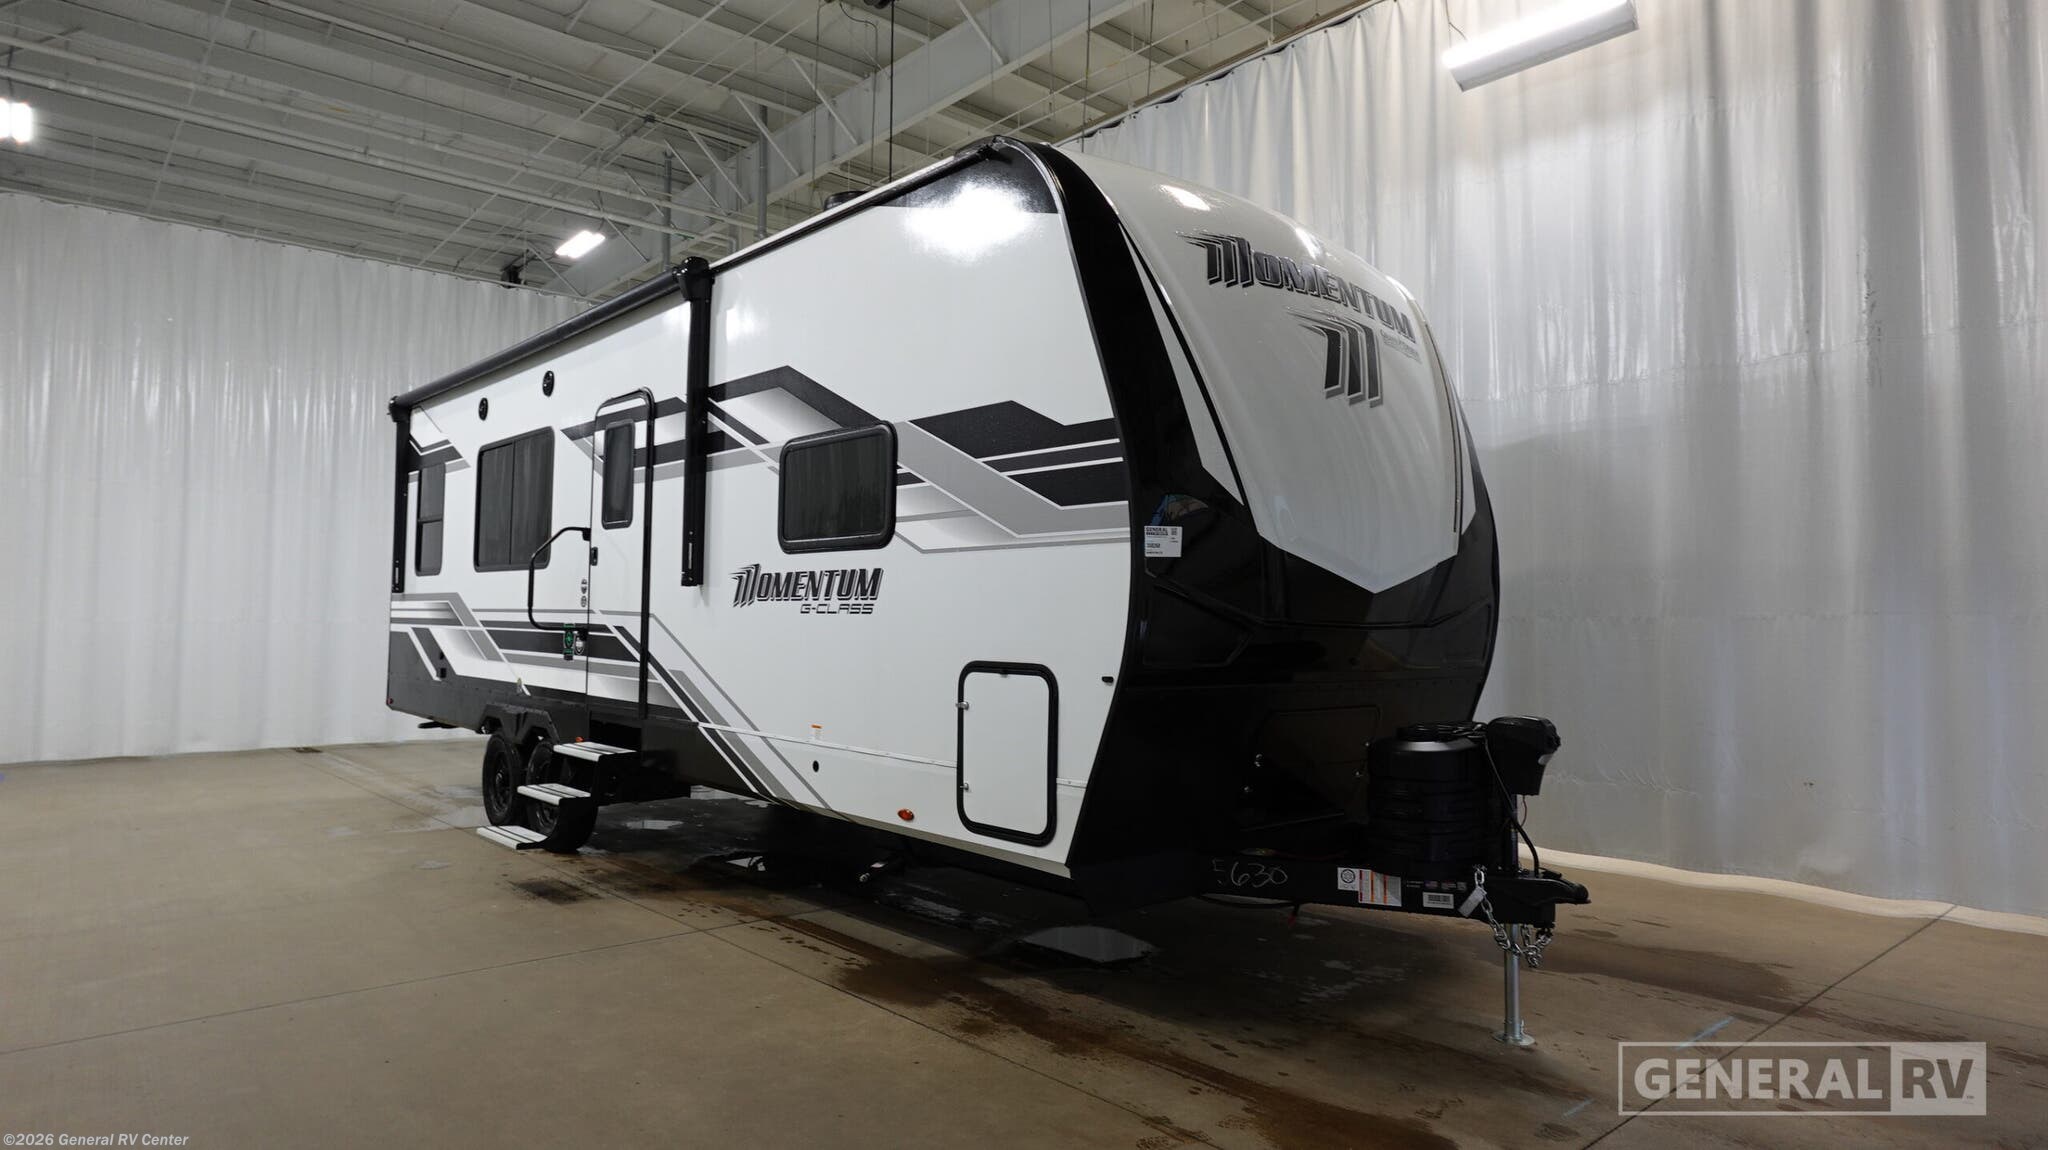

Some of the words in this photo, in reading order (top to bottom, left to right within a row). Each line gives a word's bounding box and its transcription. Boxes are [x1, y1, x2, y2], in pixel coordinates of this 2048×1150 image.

[1177, 228, 1417, 344] MOMENTUM
[730, 563, 884, 607] MOMENTUM
[800, 603, 874, 614] G-CLASS
